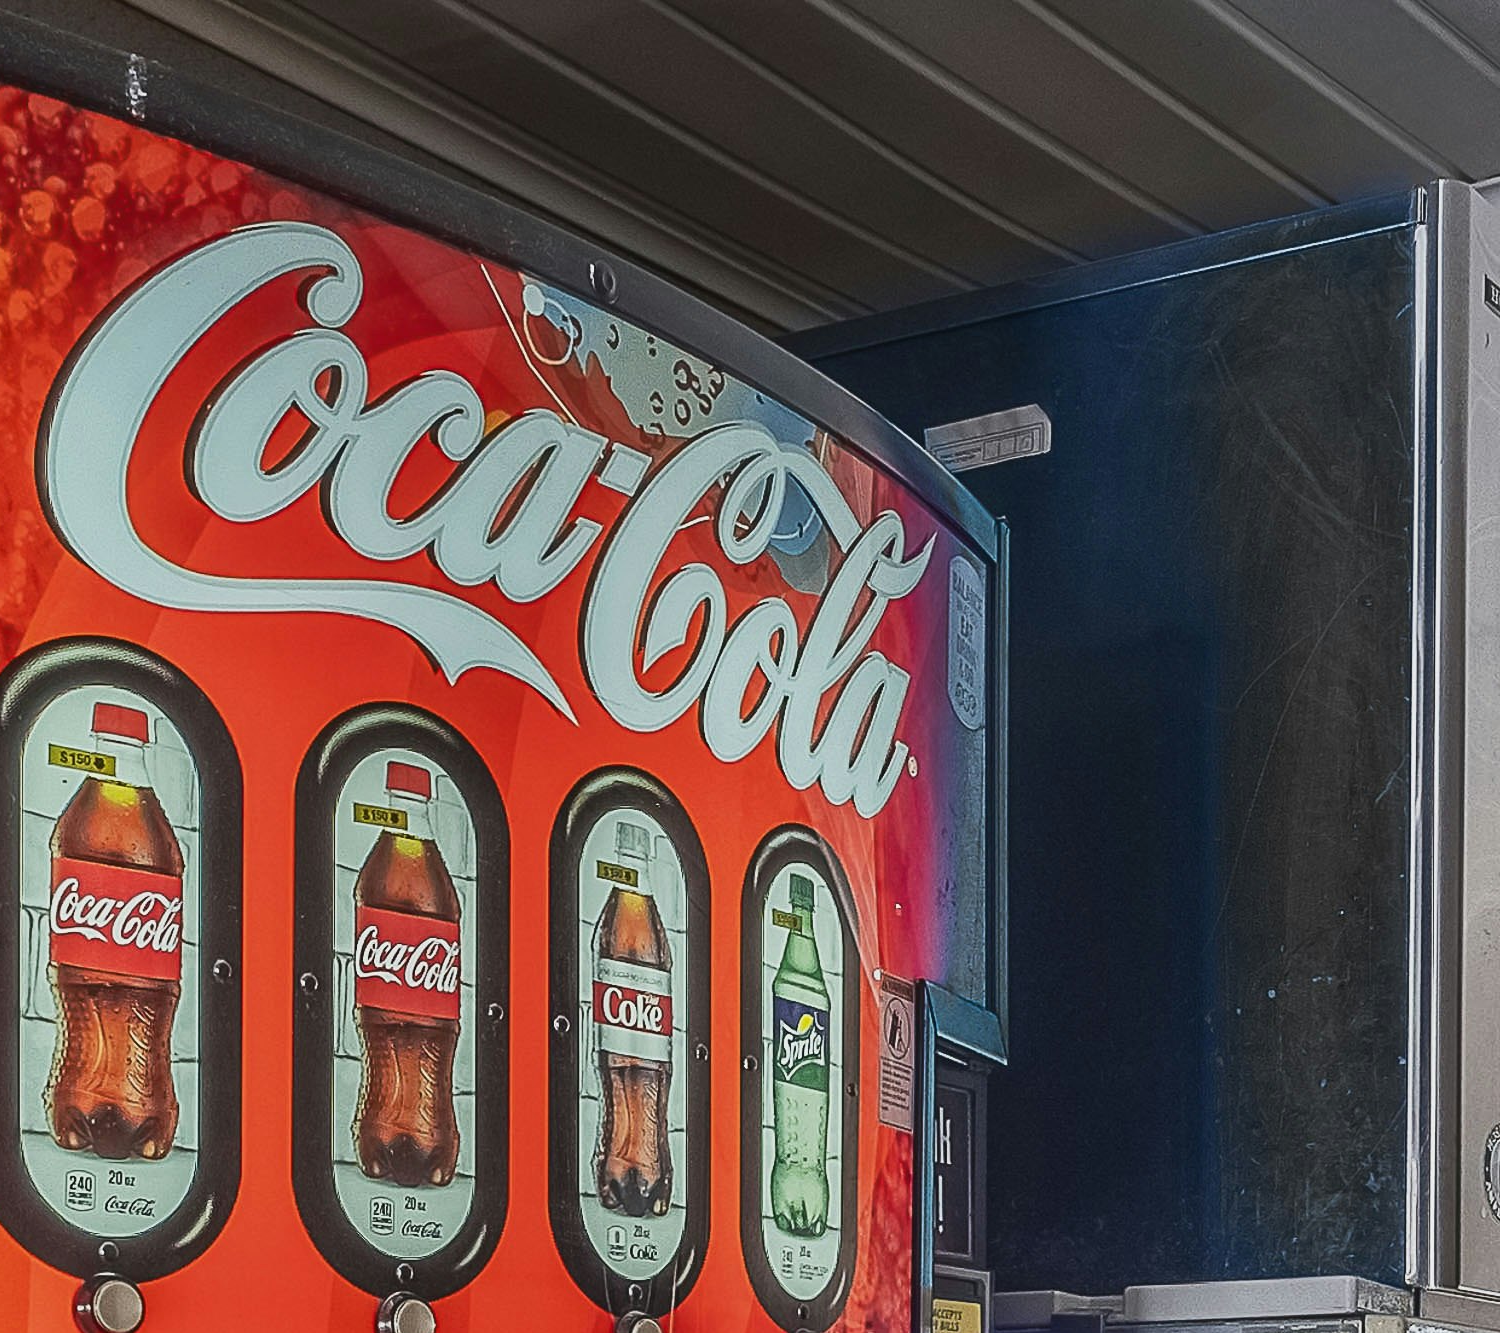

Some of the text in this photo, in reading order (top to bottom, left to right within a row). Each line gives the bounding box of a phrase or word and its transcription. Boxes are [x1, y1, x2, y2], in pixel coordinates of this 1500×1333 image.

[38, 222, 937, 818] Coca-Cola
[51, 877, 182, 953] Coca-Cola
[356, 925, 460, 993] Coca-Cola
[603, 986, 663, 1032] Coke
[780, 1026, 822, 1069] Sprite
[69, 1175, 93, 1192] 240
[108, 1169, 123, 1186] 20
